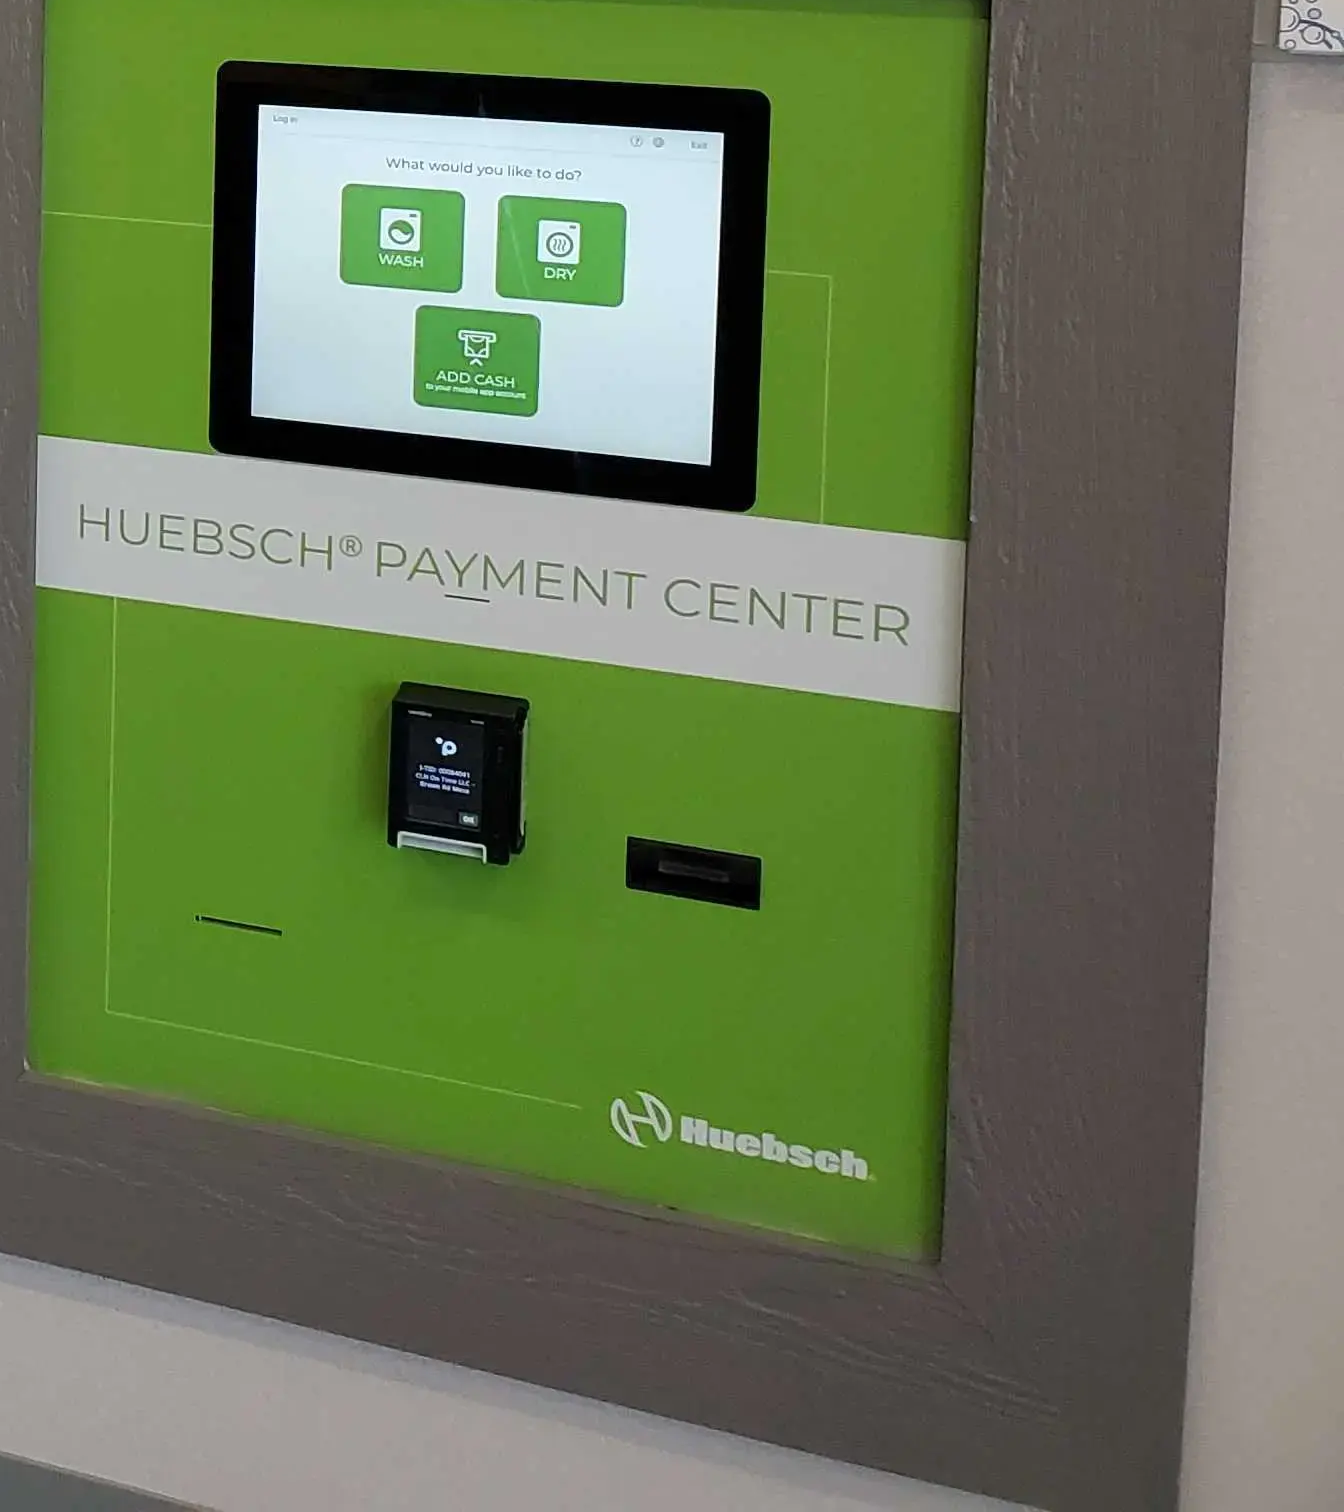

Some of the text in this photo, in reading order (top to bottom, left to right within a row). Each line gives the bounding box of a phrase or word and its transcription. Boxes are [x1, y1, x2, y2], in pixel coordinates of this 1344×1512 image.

[385, 156, 582, 183] What would you like to do?
[378, 253, 424, 268] WASH
[544, 267, 577, 281] DRY
[436, 371, 515, 388] ADD CASH
[374, 540, 647, 611] PAYMENT
[664, 578, 911, 648] CENTER
[680, 1115, 868, 1180] Huebsch
